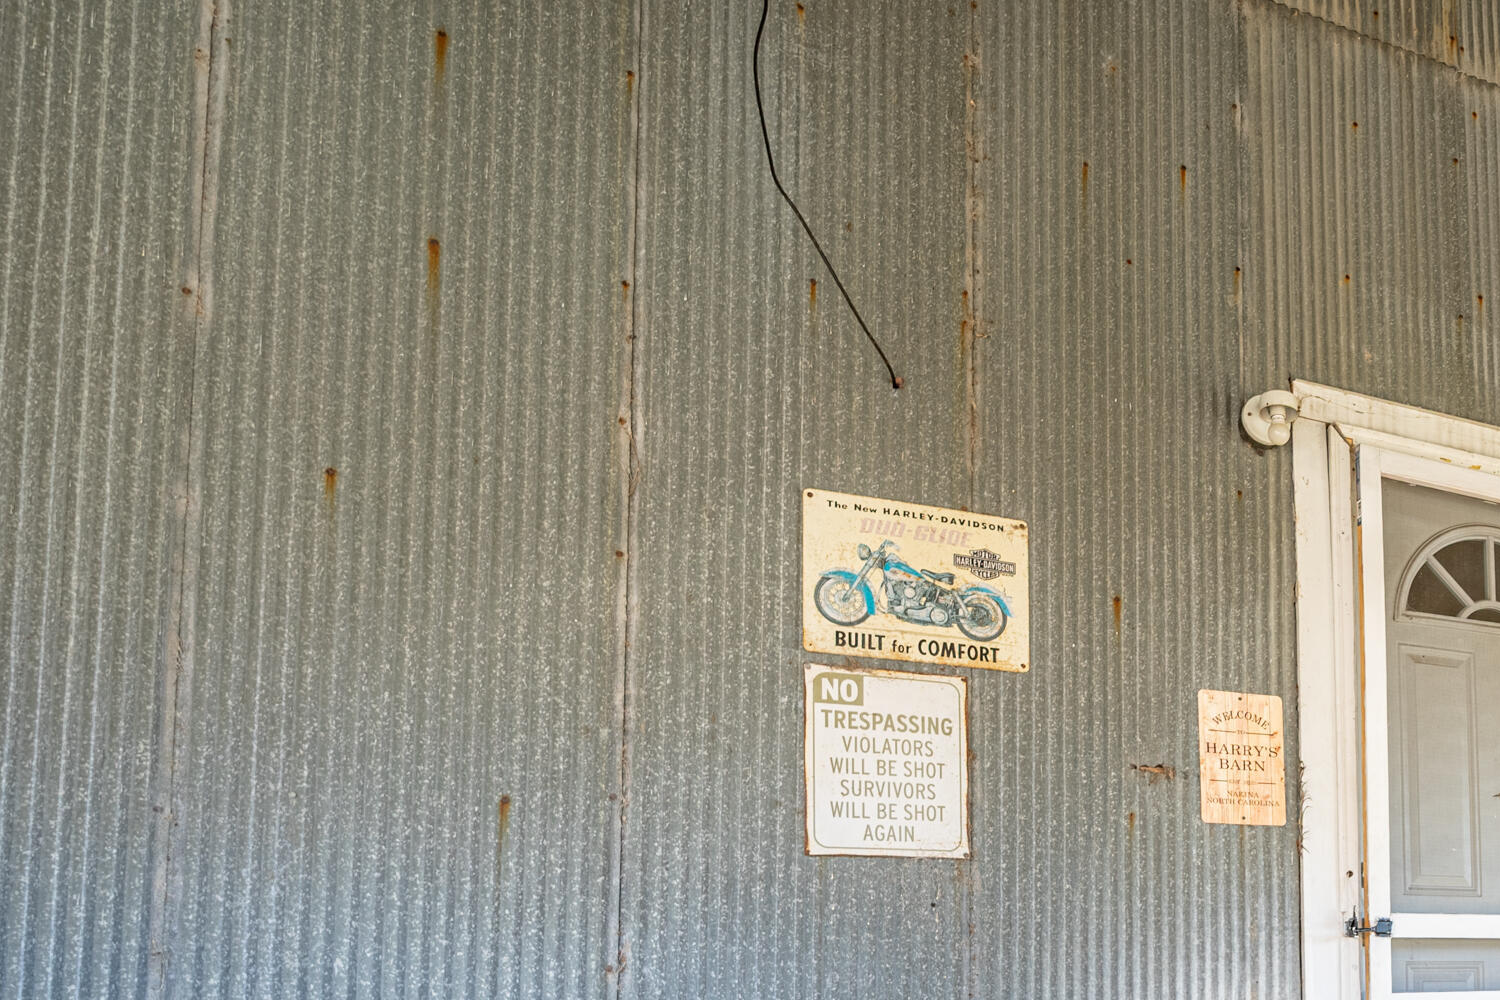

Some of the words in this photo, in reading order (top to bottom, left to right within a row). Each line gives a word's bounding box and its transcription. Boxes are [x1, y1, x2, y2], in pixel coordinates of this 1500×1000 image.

[826, 499, 849, 511] The
[853, 503, 878, 514] New
[883, 507, 1005, 532] HARLEY-DAVIDSON
[955, 555, 1015, 573] HARLEY-DAVIDSON
[834, 630, 886, 651] BUILT
[892, 640, 912, 654] for
[918, 639, 1000, 663] COMFORT
[821, 677, 859, 703] NO
[820, 708, 953, 737] TRESPASSING
[1212, 710, 1270, 730] WELCOME
[841, 735, 934, 758] VIOLATORS
[1206, 741, 1279, 758] HARRY'S
[829, 757, 870, 775] WILL
[876, 759, 897, 777] BE
[903, 761, 946, 779] SHOT
[1219, 758, 1265, 772] BARN
[840, 779, 936, 800] SURVIVORS
[830, 801, 871, 820] WILL
[877, 803, 898, 820] BE
[903, 804, 946, 822] SHOT
[1206, 797, 1235, 806] NORTH
[1237, 799, 1280, 808] CAROLINA
[863, 824, 915, 842] AGAIN
